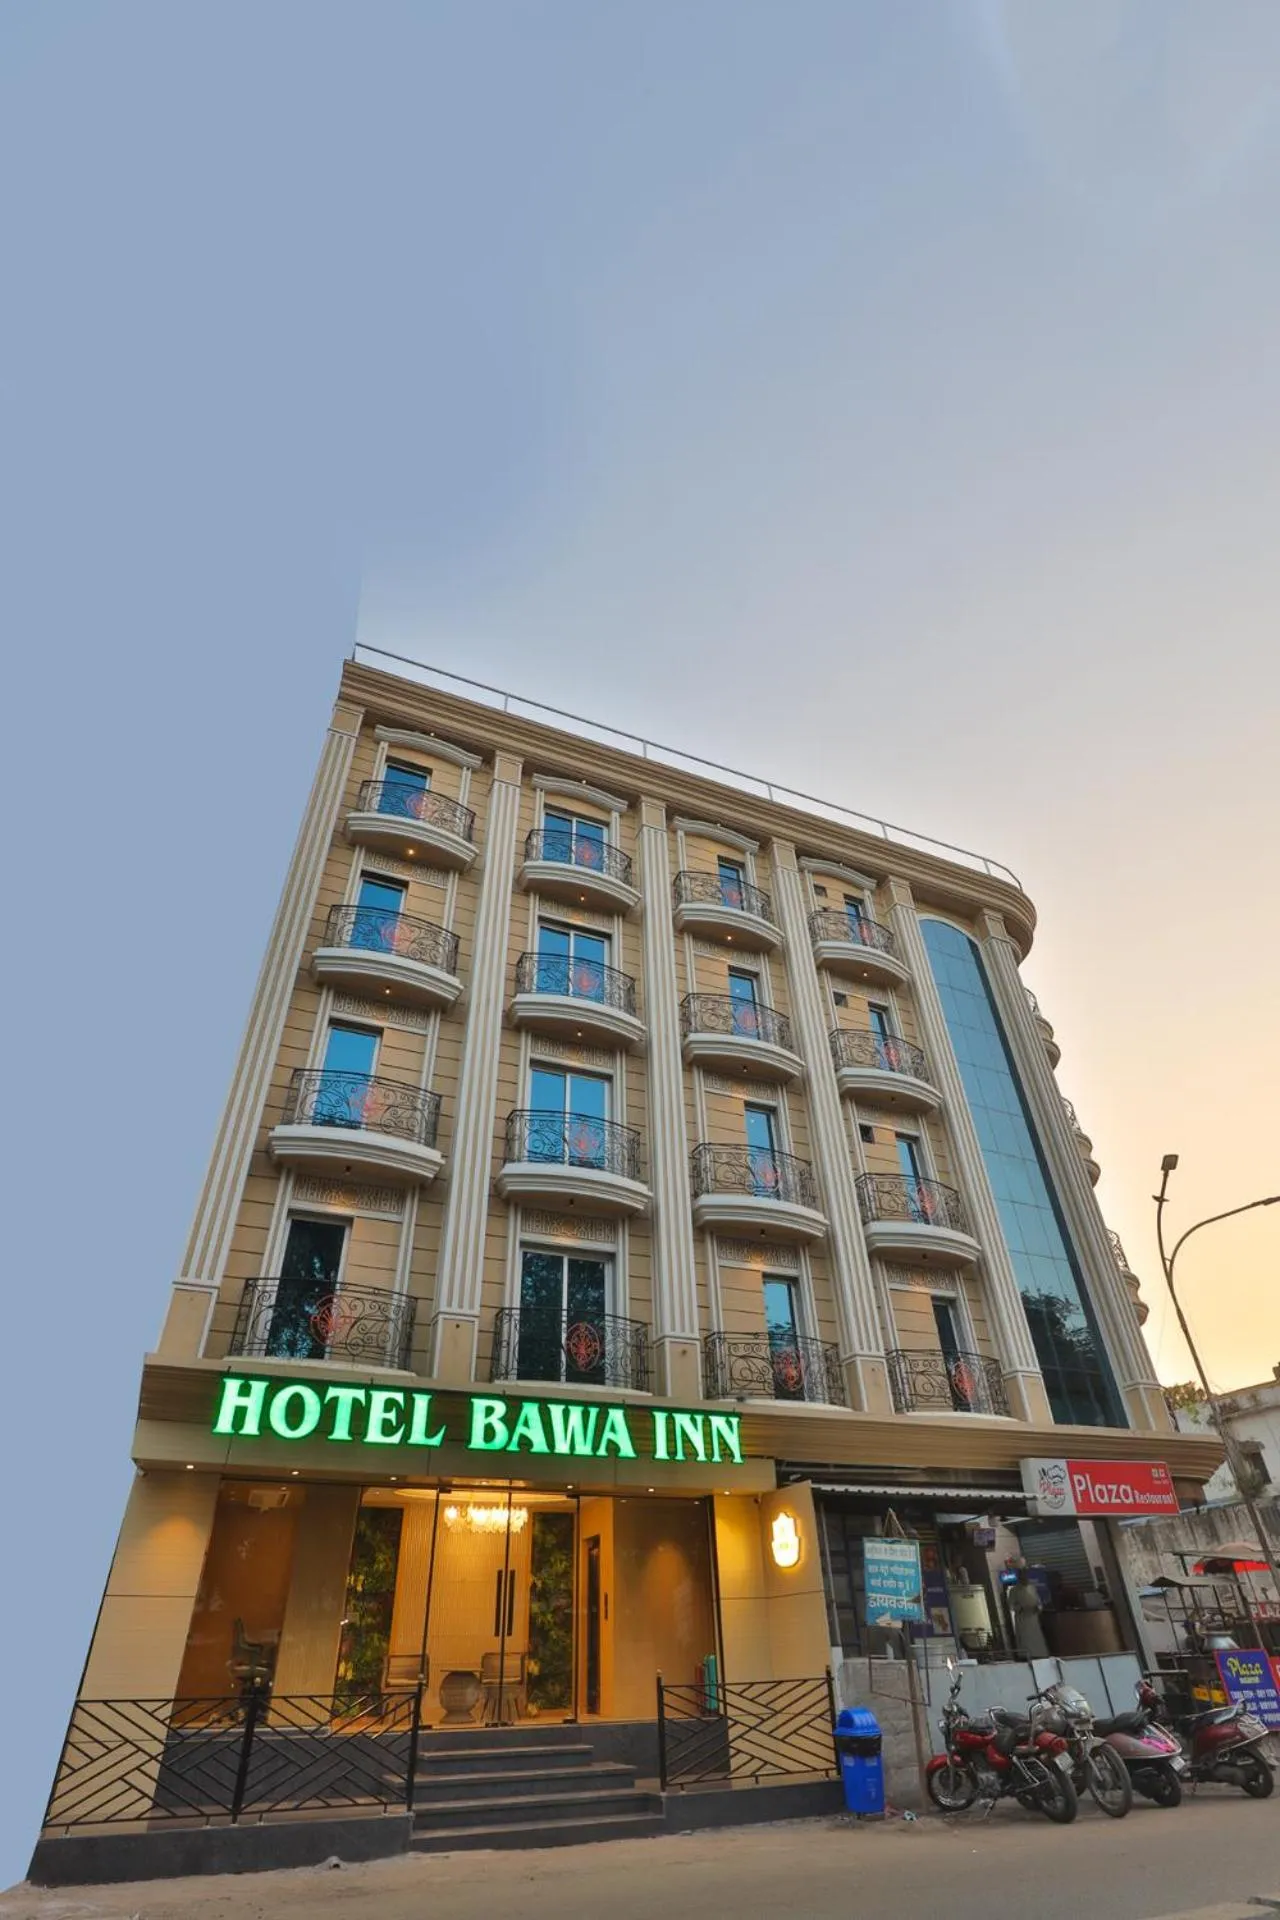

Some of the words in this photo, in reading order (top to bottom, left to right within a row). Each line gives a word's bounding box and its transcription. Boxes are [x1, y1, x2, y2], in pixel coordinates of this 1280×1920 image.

[212, 1378, 447, 1447] HOTEL
[468, 1398, 638, 1458] BAWA
[652, 1411, 744, 1464] INN
[1073, 1473, 1134, 1504] Plaza
[1227, 1656, 1264, 1678] Plaza
